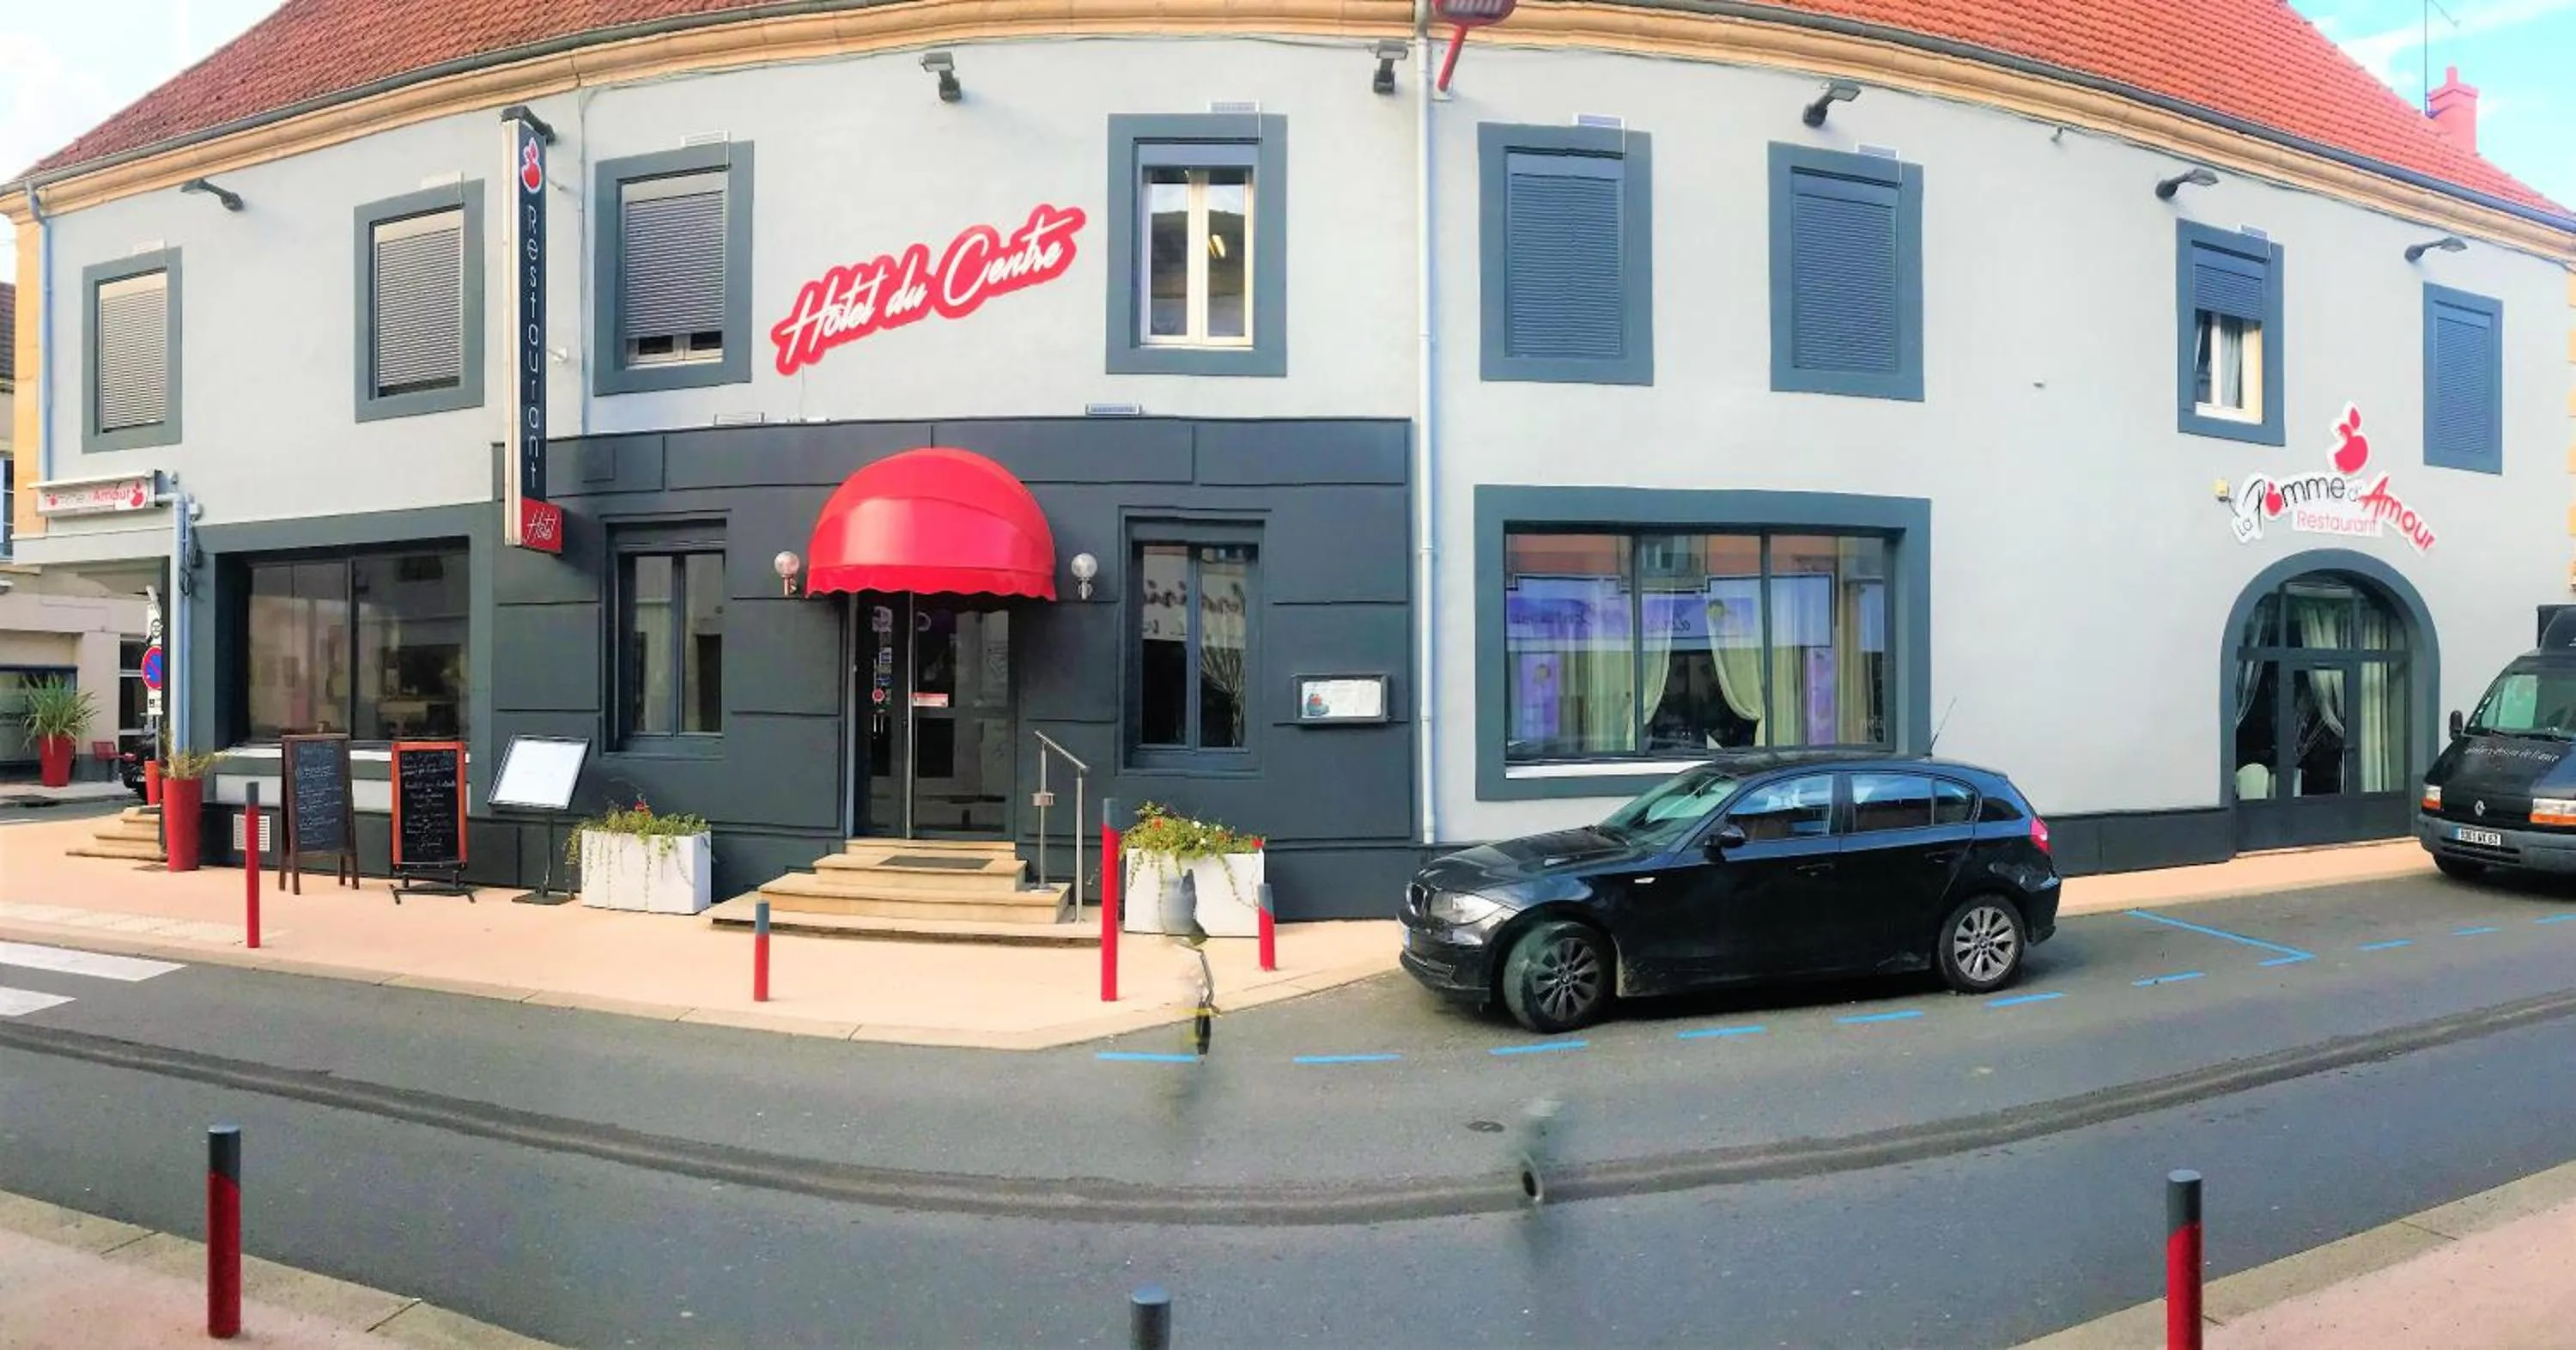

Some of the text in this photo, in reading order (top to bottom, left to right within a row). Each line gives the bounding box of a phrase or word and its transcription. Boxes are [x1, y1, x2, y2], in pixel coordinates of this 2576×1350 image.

[884, 252, 928, 319] du
[943, 213, 1074, 307] Centre
[526, 204, 541, 489] Restaurant
[2238, 518, 2255, 537] La
[2296, 511, 2378, 532] Restaurant
